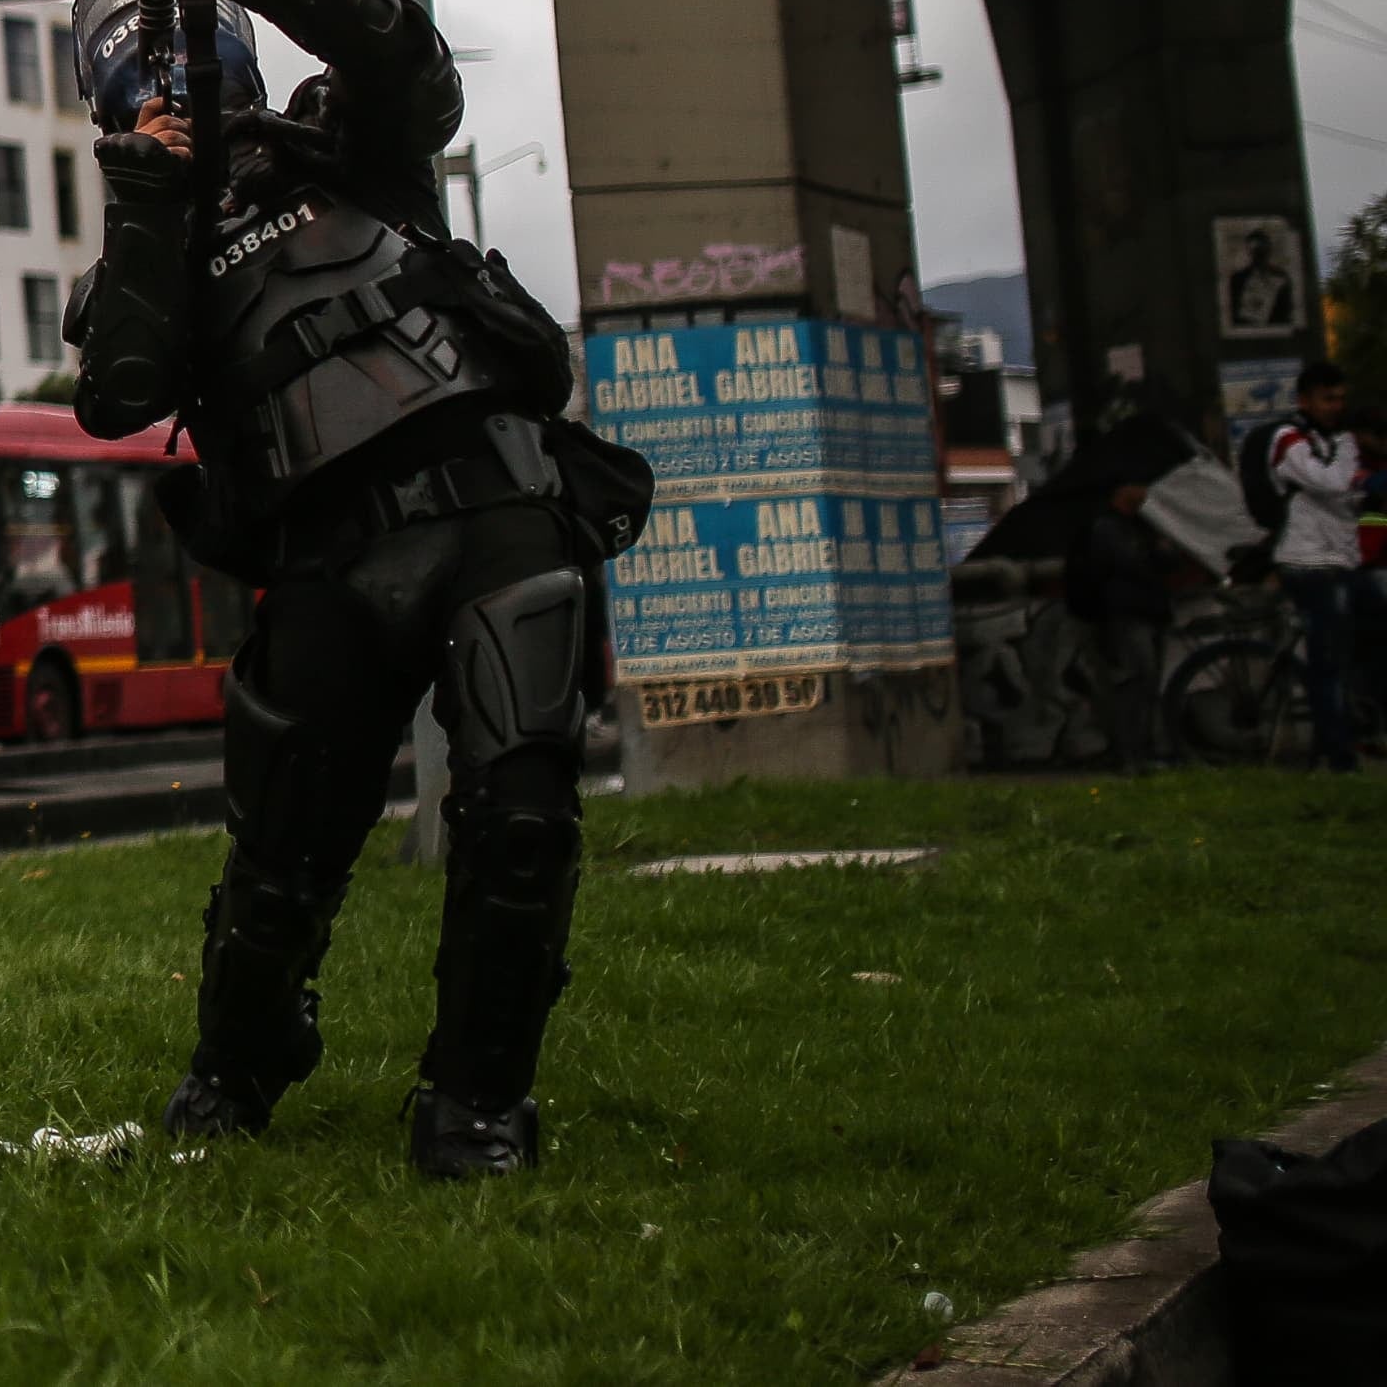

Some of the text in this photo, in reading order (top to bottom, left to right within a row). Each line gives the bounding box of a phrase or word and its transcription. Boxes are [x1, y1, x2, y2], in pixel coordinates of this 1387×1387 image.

[210, 203, 316, 276] 038401
[615, 333, 679, 375] ANA
[735, 325, 800, 365] ANA
[595, 371, 705, 413] GABRIEL
[621, 415, 713, 442] CONCIERTO
[735, 451, 760, 470] DE
[757, 499, 822, 540] ANA
[615, 545, 725, 586] GABRIEL
[738, 537, 838, 578] GABRIE
[641, 590, 732, 615] CONCIERTO
[633, 632, 659, 653] DE
[664, 628, 735, 651] AGOSTO
[758, 626, 784, 645] DE
[644, 692, 688, 721] 312
